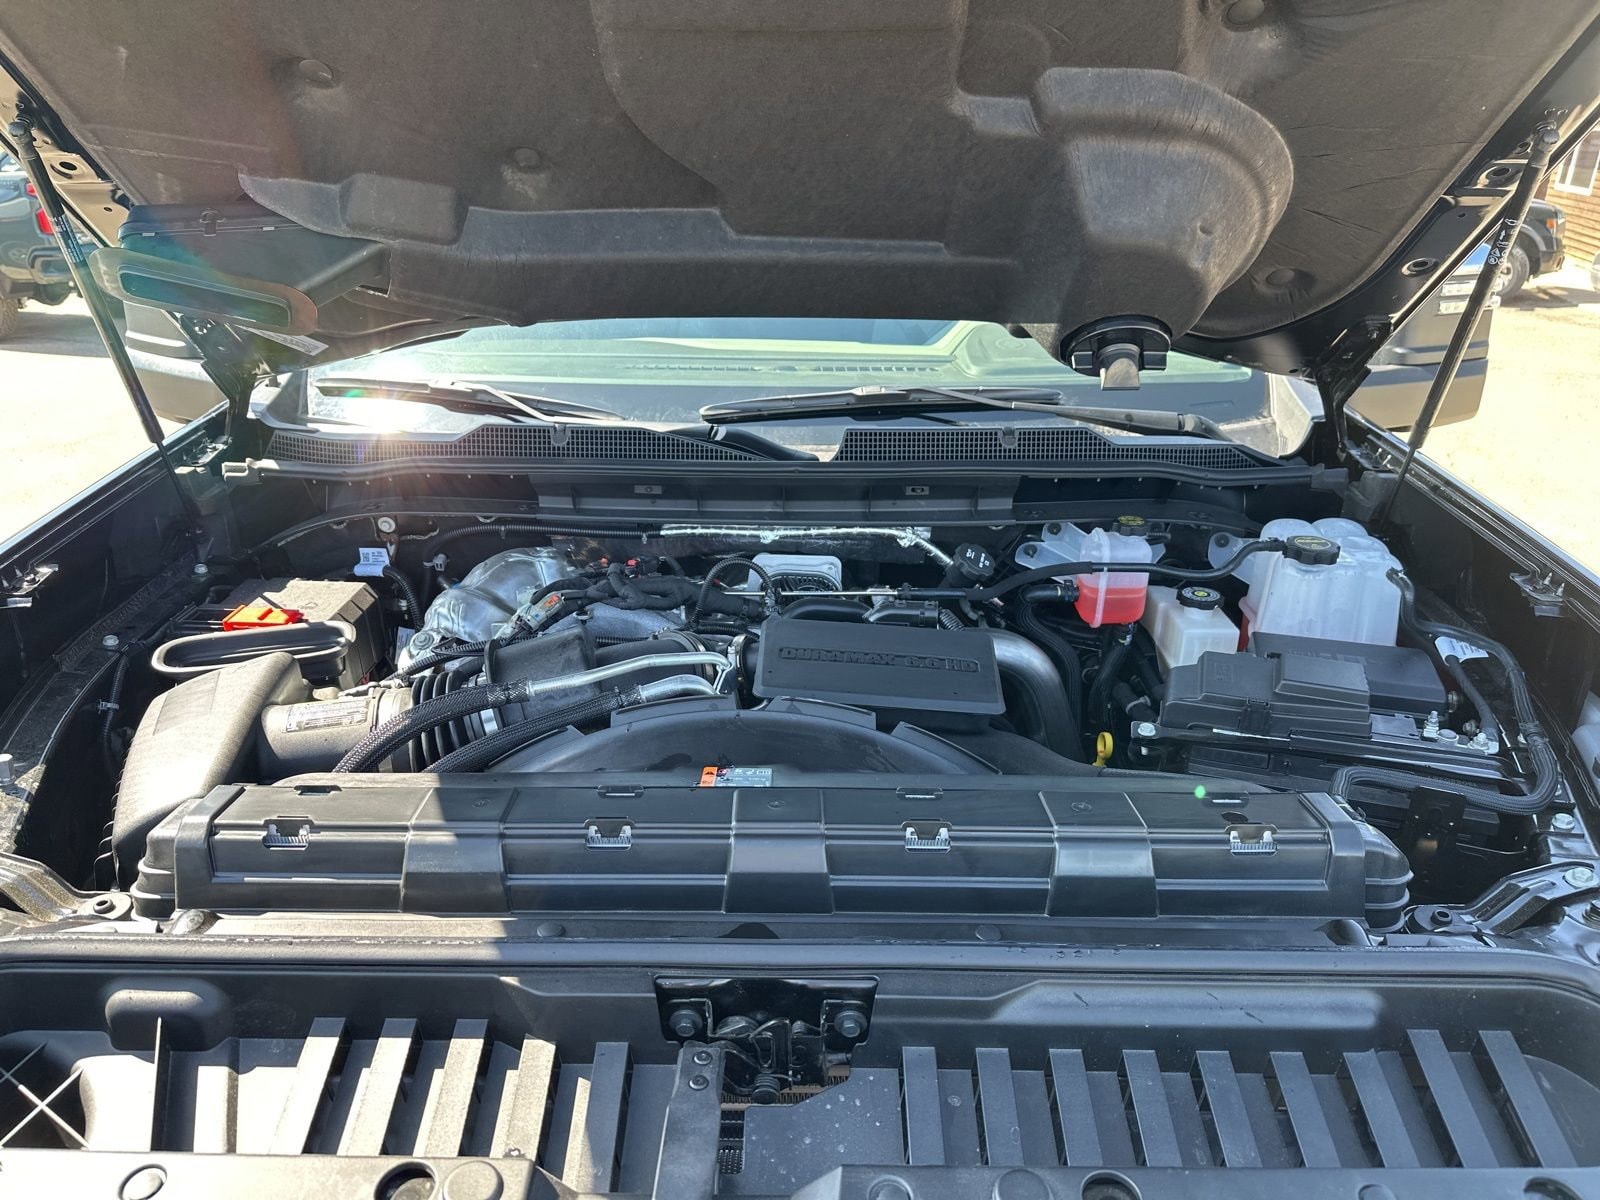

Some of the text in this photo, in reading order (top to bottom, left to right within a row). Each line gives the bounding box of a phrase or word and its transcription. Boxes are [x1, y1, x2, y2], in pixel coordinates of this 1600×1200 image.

[781, 648, 979, 672] DURAMAX 6.6 HD
